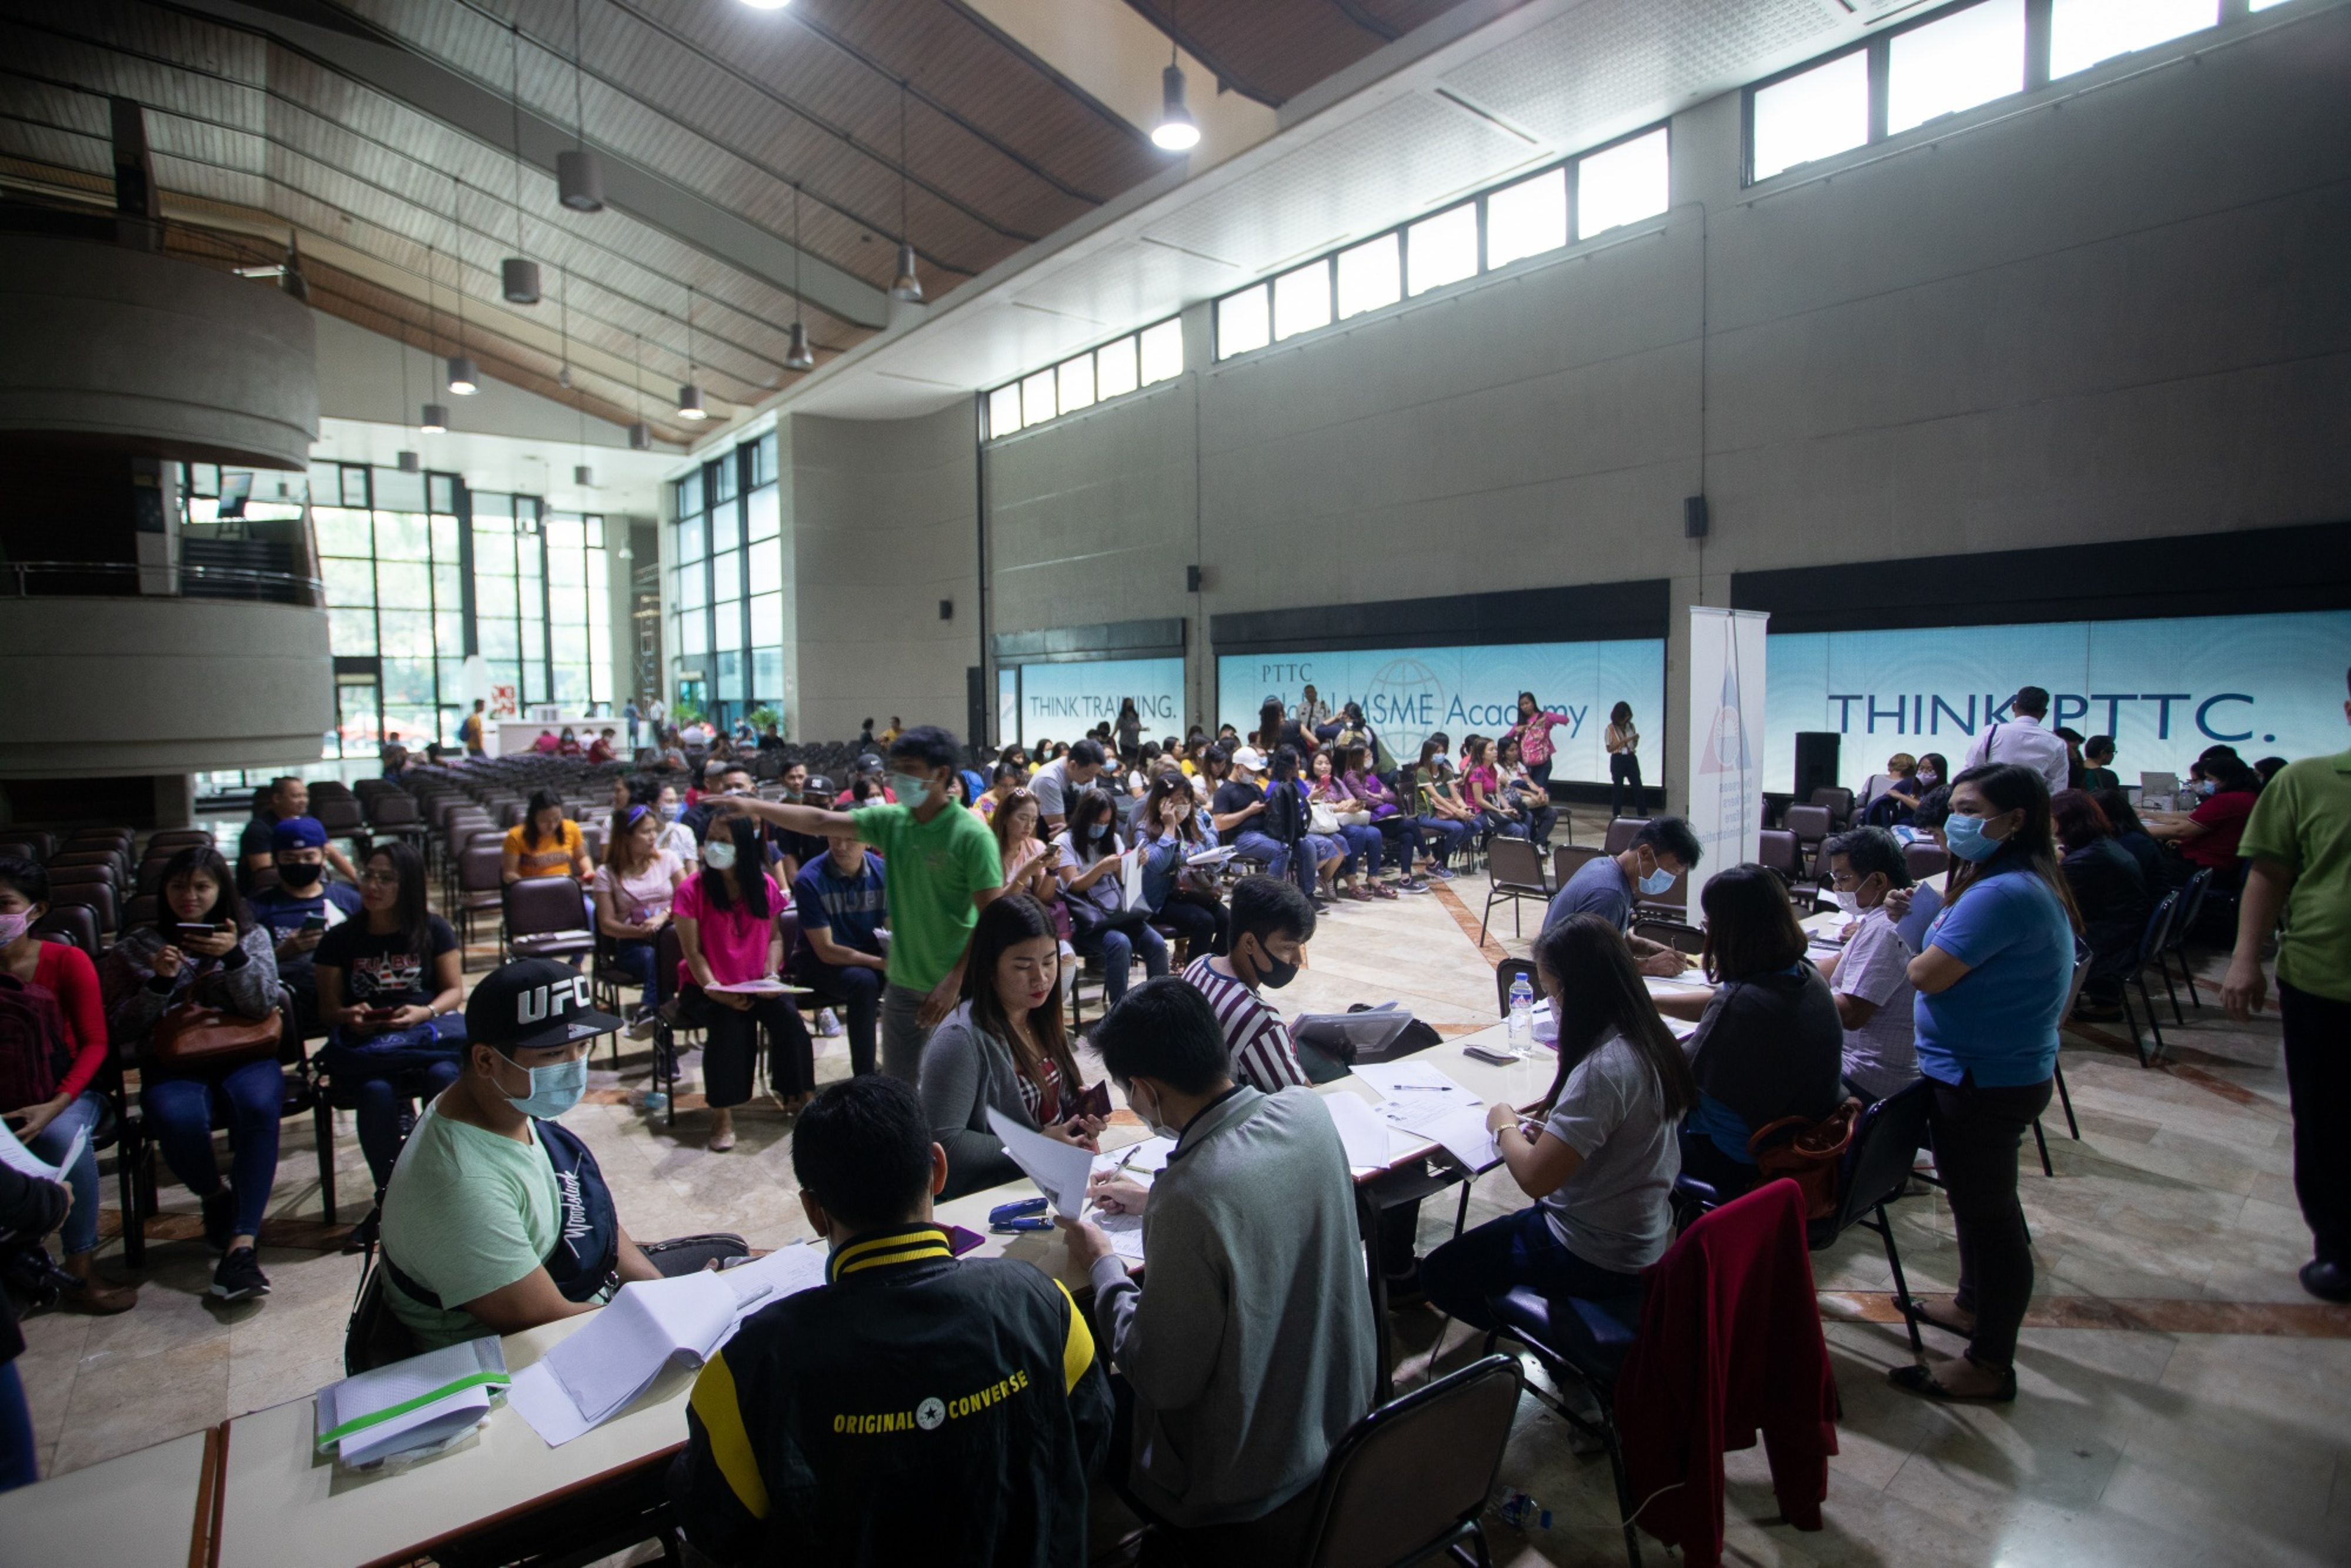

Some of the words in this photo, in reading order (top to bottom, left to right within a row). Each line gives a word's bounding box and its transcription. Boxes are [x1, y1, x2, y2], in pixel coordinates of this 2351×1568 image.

[1263, 663, 1312, 683] PTTC
[1030, 696, 1079, 717] THINK
[1081, 694, 1176, 718] TRAIING.
[1445, 690, 1588, 738] Acadmy
[1828, 694, 2018, 736] THINK
[2053, 694, 2276, 743] PTTC.
[517, 975, 590, 1024] UFC
[834, 1411, 915, 1434] ORIGINAL
[949, 1369, 1028, 1419] CONVERSE
